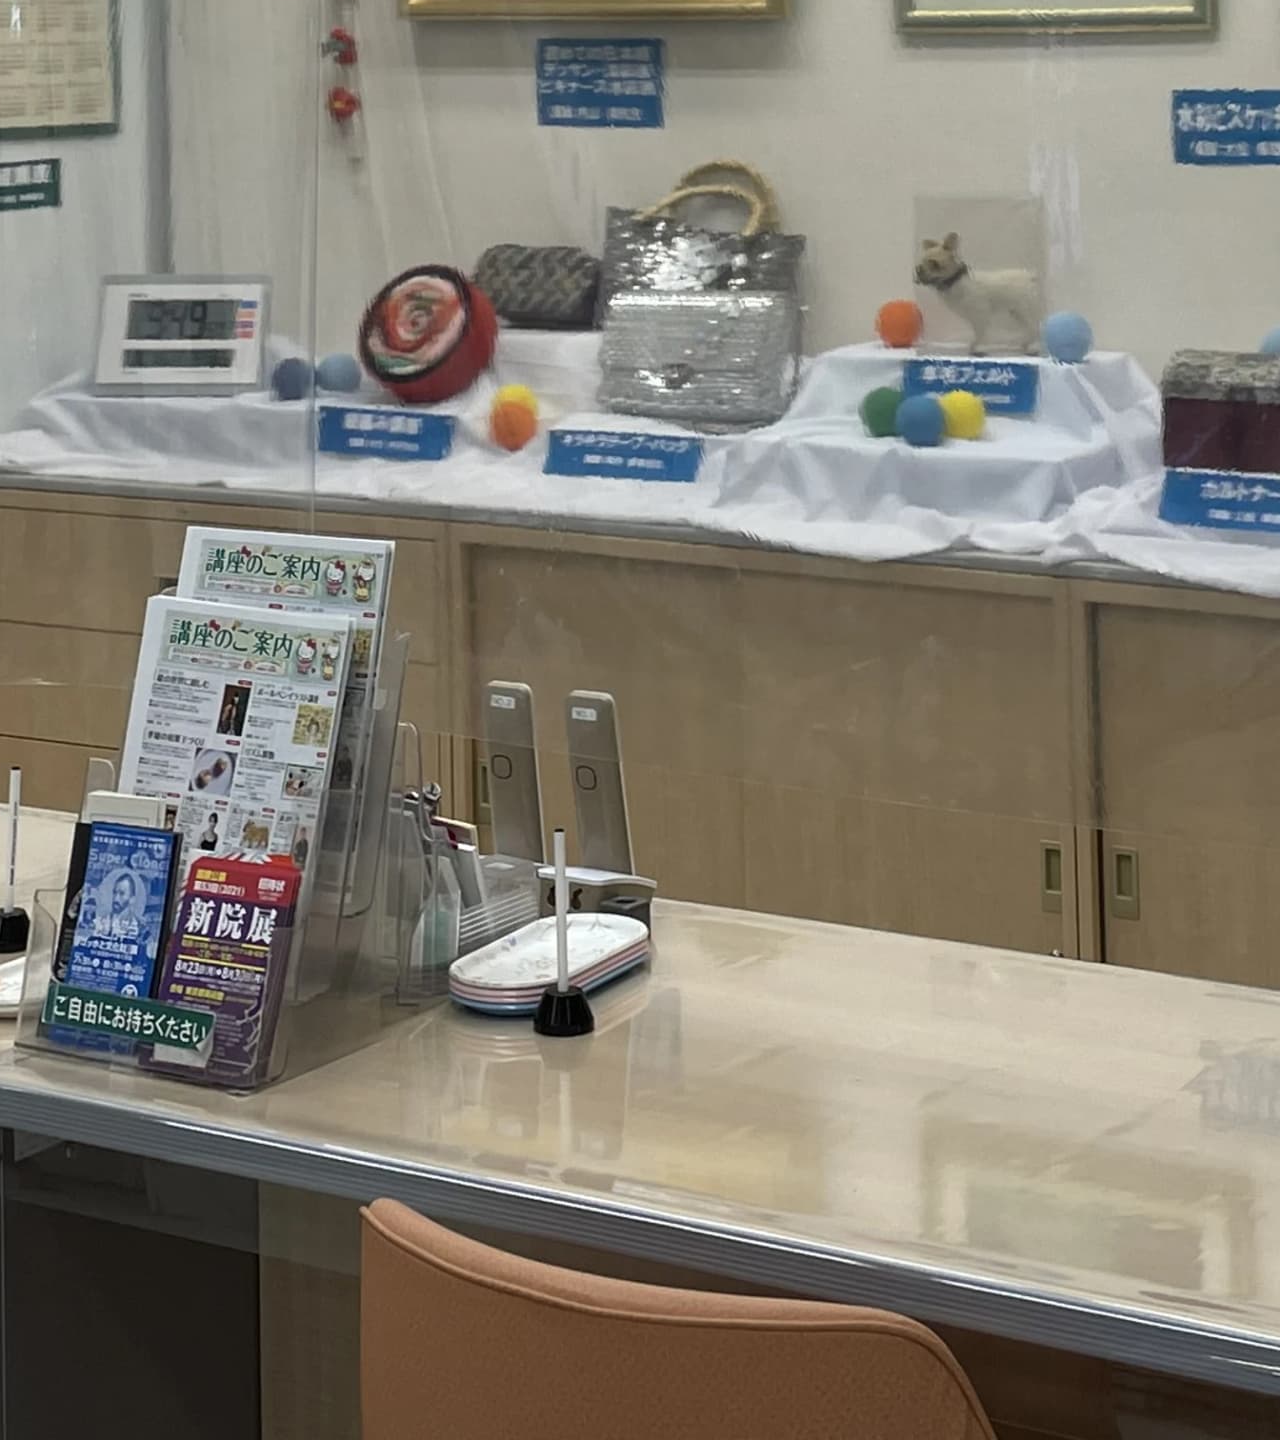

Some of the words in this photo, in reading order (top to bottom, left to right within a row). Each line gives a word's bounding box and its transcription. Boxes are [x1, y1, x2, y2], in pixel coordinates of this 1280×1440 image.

[205, 546, 321, 582] 講座のご案内
[169, 618, 294, 660] 講座のご案内
[185, 897, 278, 945] 新院展
[53, 996, 207, 1044] ご自由にお持ちください
